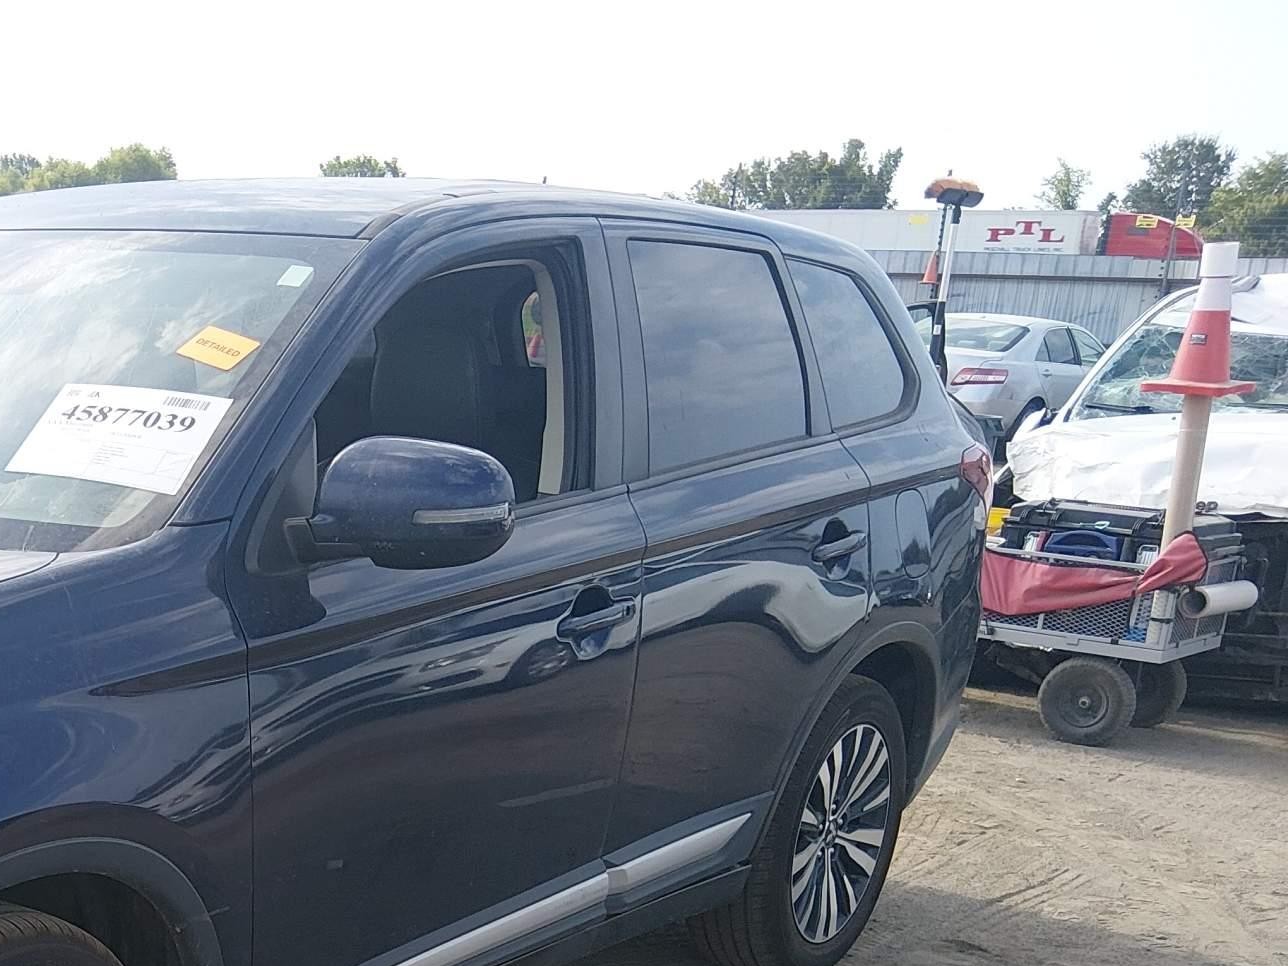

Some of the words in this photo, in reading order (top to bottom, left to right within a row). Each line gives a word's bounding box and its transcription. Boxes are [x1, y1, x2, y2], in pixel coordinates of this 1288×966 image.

[985, 220, 1065, 243] PTL
[195, 338, 241, 357] DETAILED
[61, 404, 197, 433] 45877039
